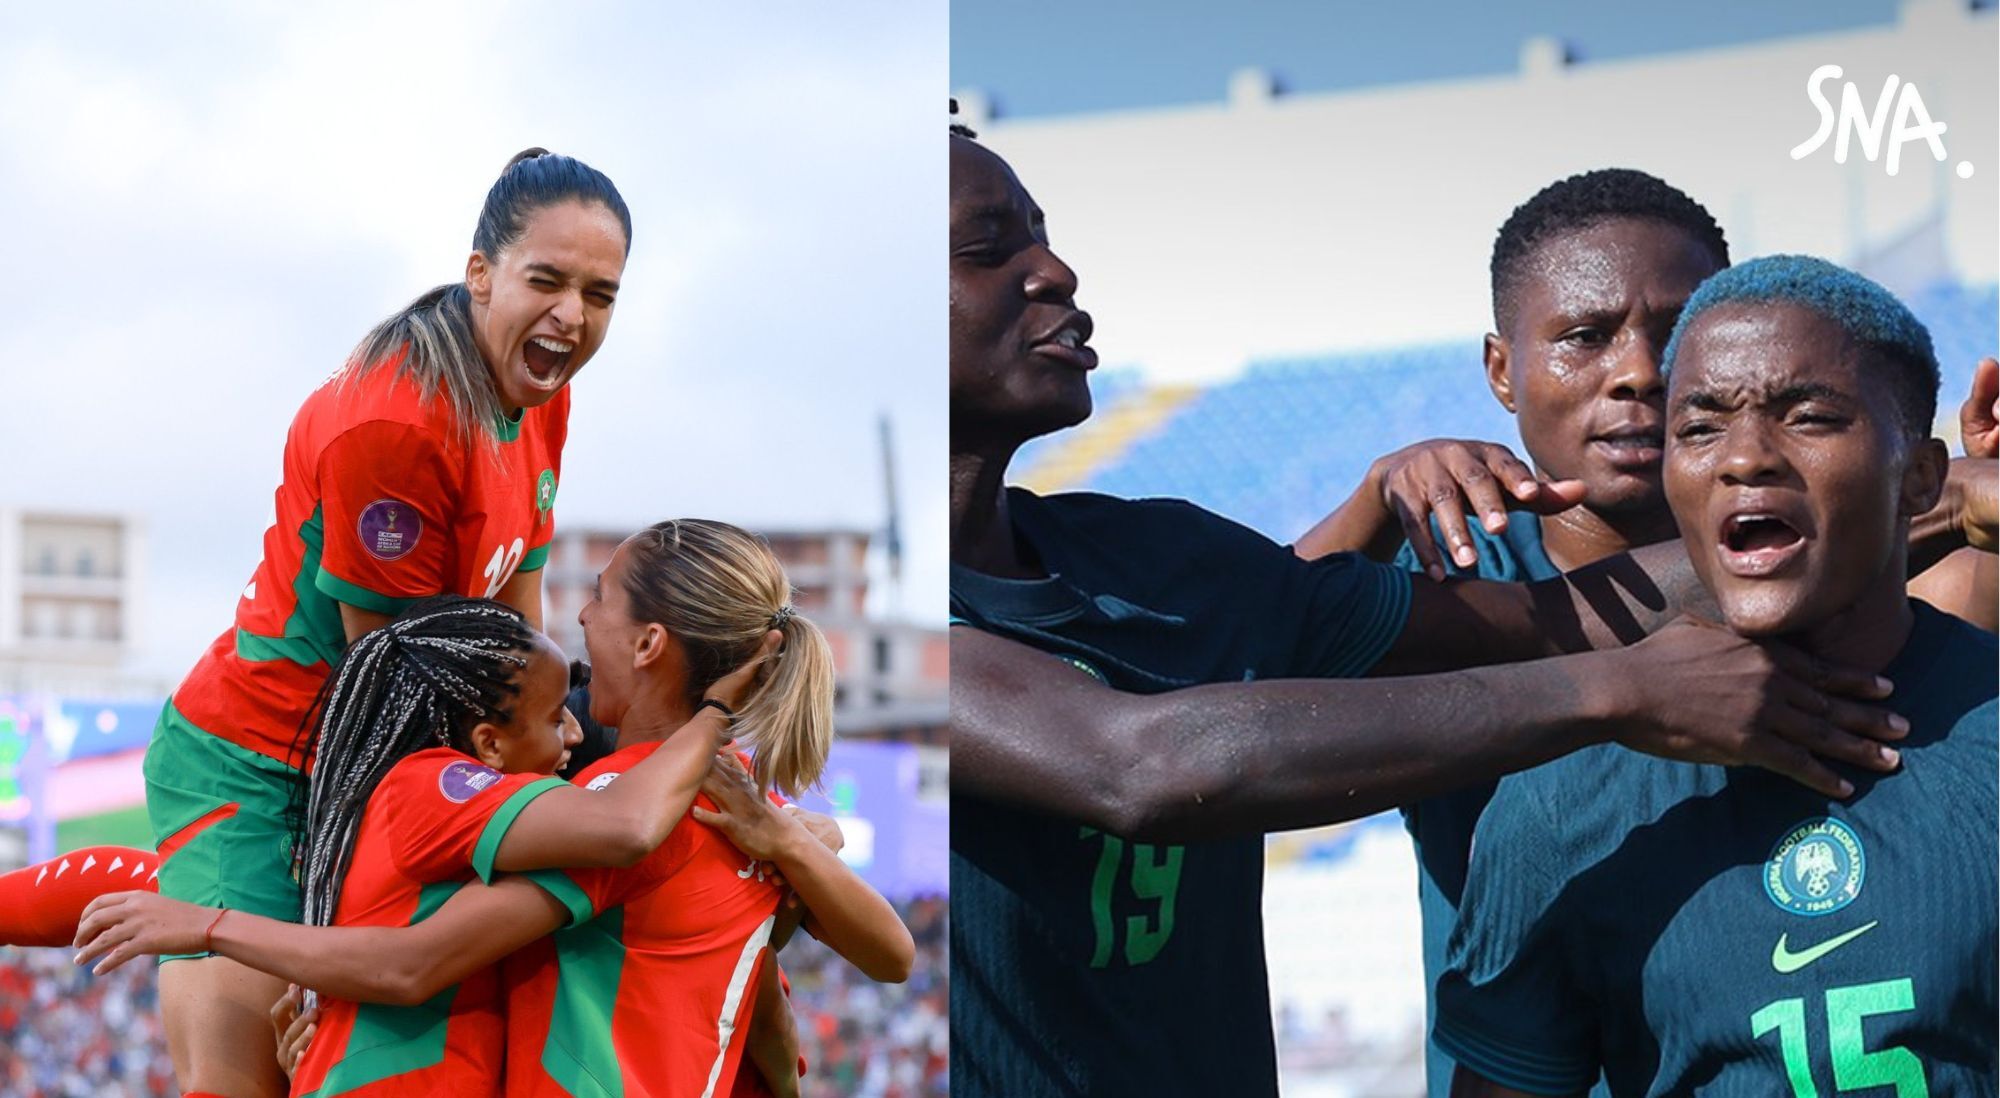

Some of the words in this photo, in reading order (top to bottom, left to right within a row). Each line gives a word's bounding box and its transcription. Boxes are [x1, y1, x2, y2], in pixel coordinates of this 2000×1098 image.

[1078, 826, 1186, 968] 19
[1774, 823, 1828, 863] FOOTBALL
[1751, 978, 1930, 1098] 15
